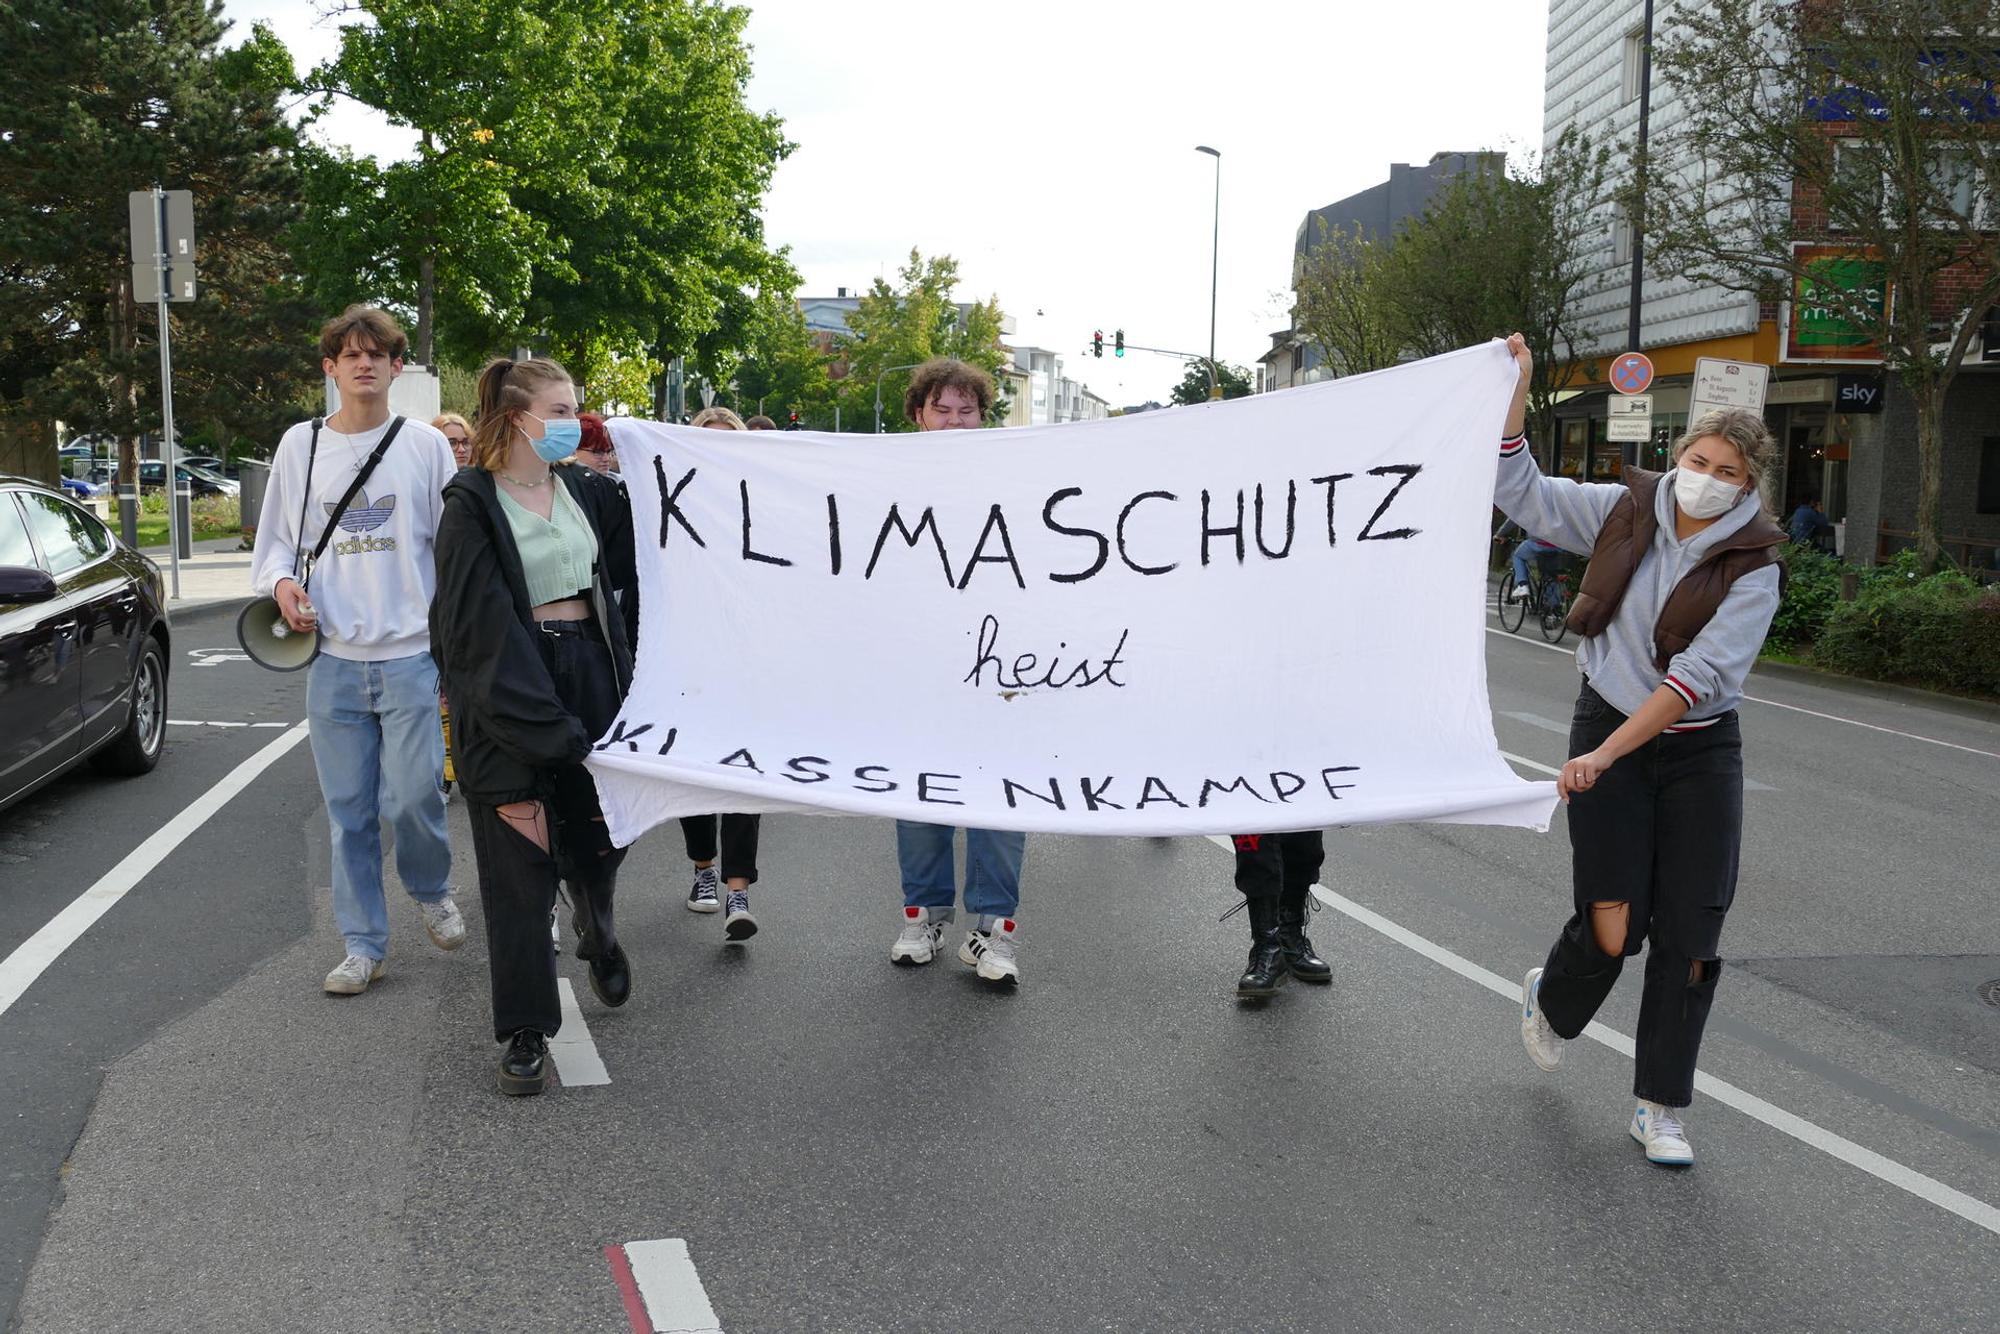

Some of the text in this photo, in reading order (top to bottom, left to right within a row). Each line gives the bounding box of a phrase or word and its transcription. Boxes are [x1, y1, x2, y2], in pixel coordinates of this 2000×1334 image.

[1841, 383, 1877, 405] sky
[335, 535, 397, 556] adidas
[652, 454, 1423, 590] KLIMASCHUTZ
[964, 614, 1129, 688] heist
